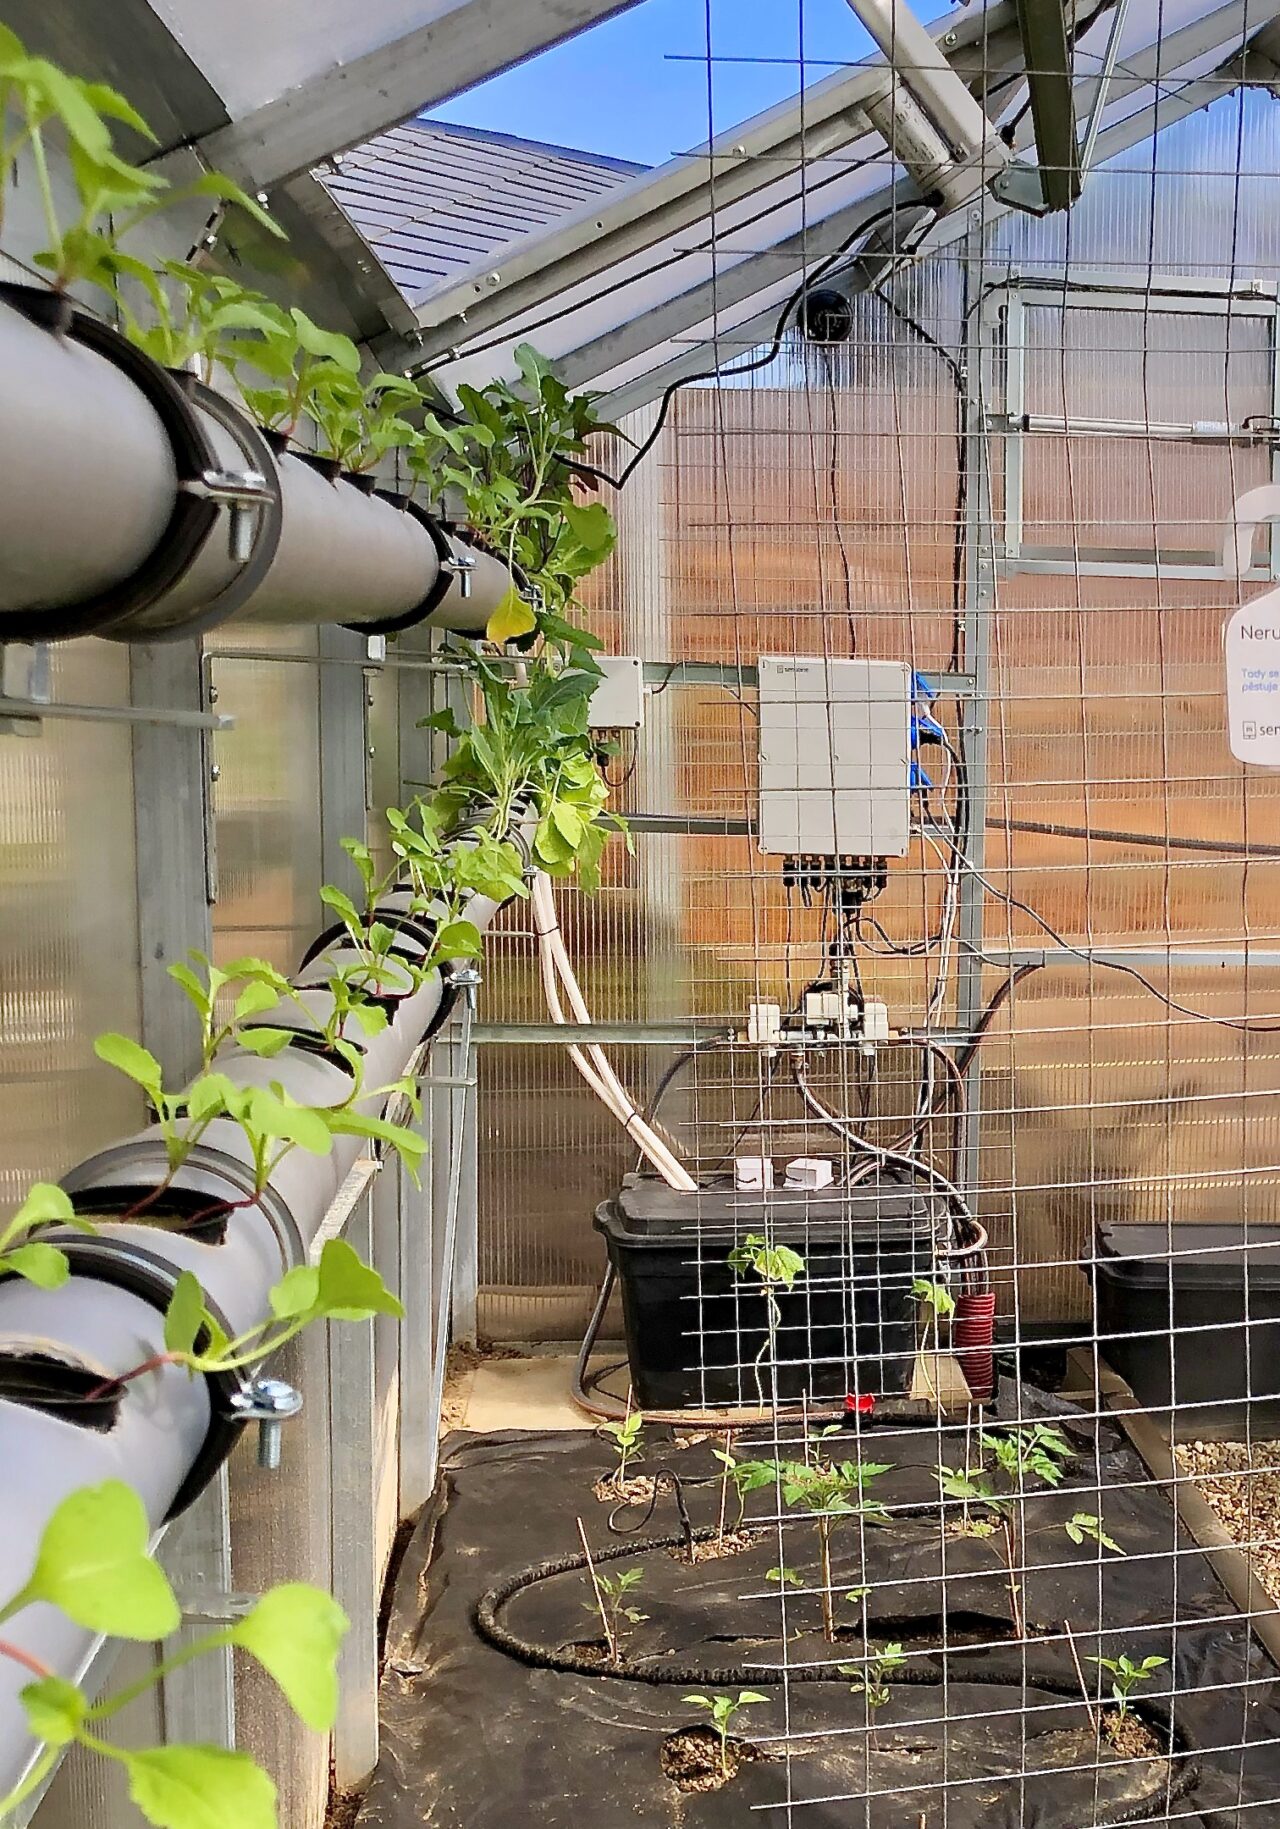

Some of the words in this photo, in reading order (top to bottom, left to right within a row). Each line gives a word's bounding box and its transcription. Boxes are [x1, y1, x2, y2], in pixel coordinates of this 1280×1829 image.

[1241, 667, 1266, 681] Tady
[1269, 671, 1280, 679] se
[1241, 681, 1279, 693] pěstuje
